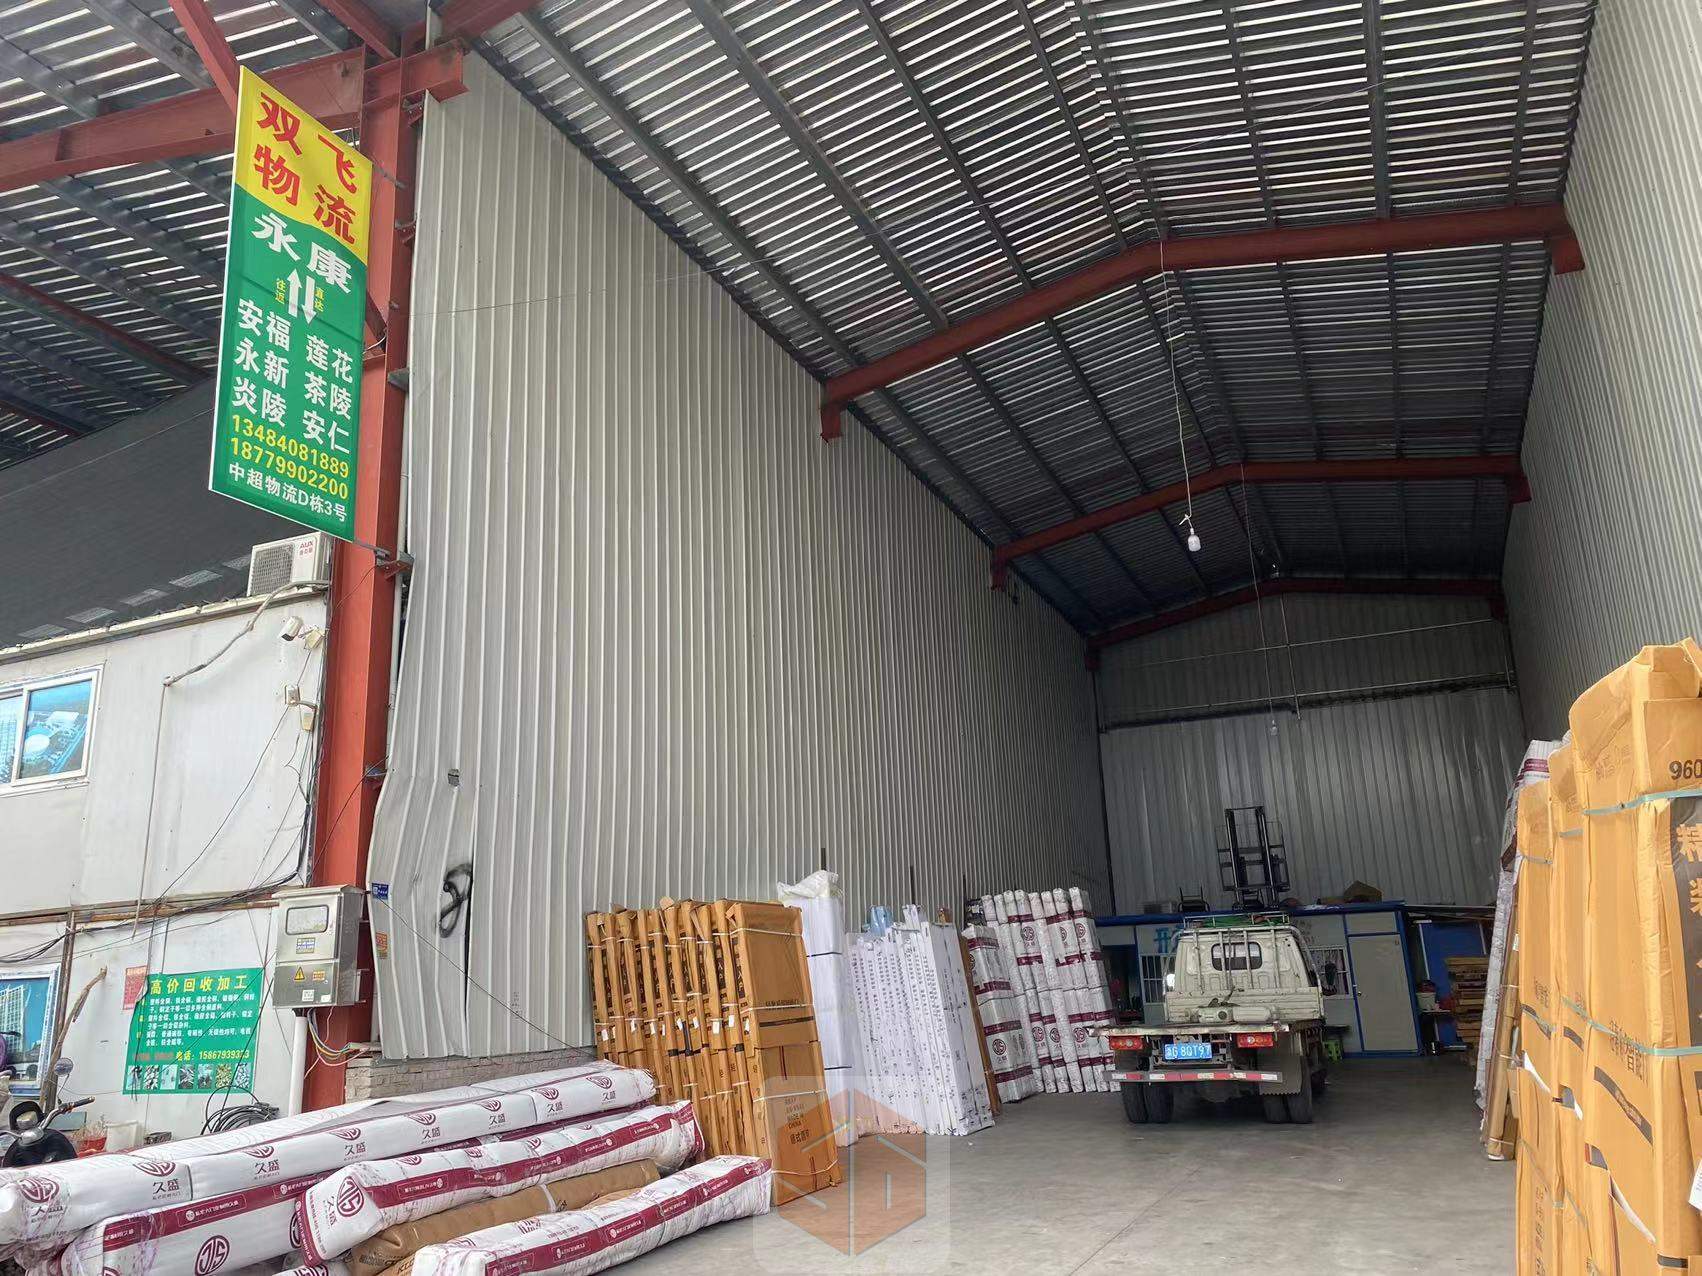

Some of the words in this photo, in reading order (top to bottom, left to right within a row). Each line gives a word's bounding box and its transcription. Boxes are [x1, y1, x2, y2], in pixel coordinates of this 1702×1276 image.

[256, 91, 357, 194] 双飞
[254, 144, 356, 245] 物流
[251, 212, 352, 294] 永康
[237, 298, 292, 352] 安福
[306, 334, 354, 384] 莲花
[234, 336, 290, 389] 永新
[303, 370, 353, 420] 茶陵
[231, 376, 287, 428] 炎陵
[302, 409, 351, 455] 安仁
[232, 414, 349, 479] 13484081889
[229, 462, 348, 523] 中超物流D栋3号
[231, 437, 349, 500] 18779902200
[150, 975, 248, 995] 高价回收加工
[254, 1159, 280, 1174] 久盛
[344, 1141, 367, 1156] 久盛
[151, 1178, 180, 1194] 久盛
